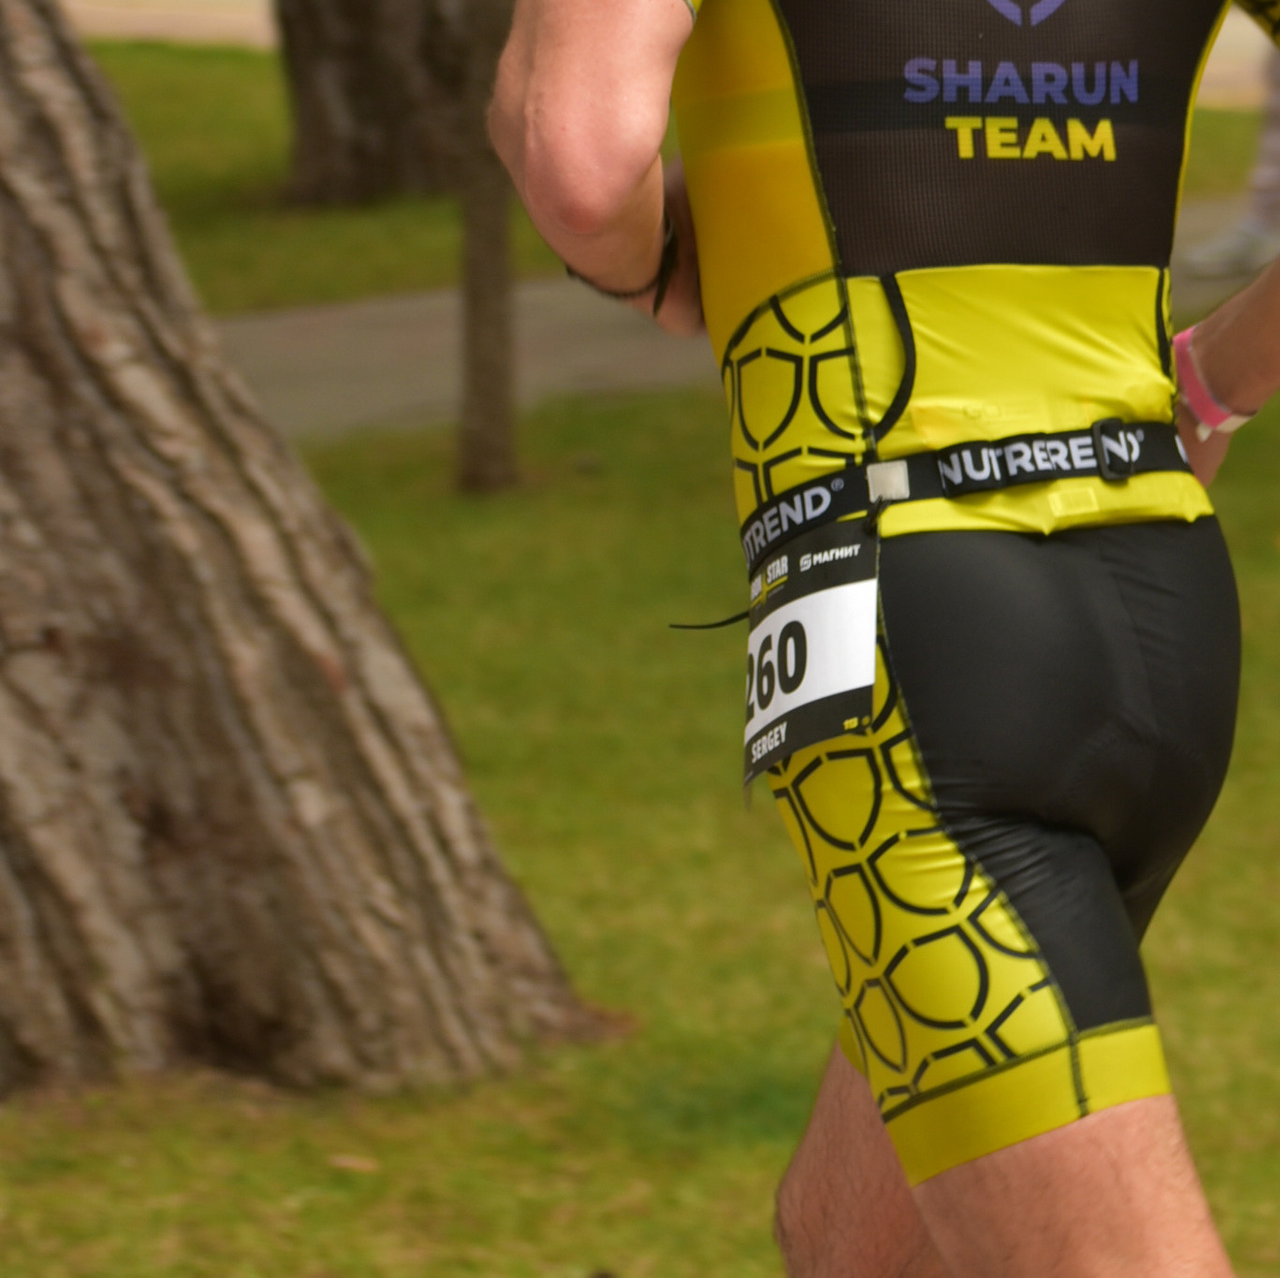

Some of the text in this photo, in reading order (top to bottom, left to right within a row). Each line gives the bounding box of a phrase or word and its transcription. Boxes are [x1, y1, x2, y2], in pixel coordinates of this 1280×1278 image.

[903, 57, 1139, 106] SHARUN
[944, 116, 1116, 162] TEAM
[766, 554, 789, 585] STAR
[812, 543, 861, 567] МАГНИТ
[751, 720, 788, 764] SERGEY
